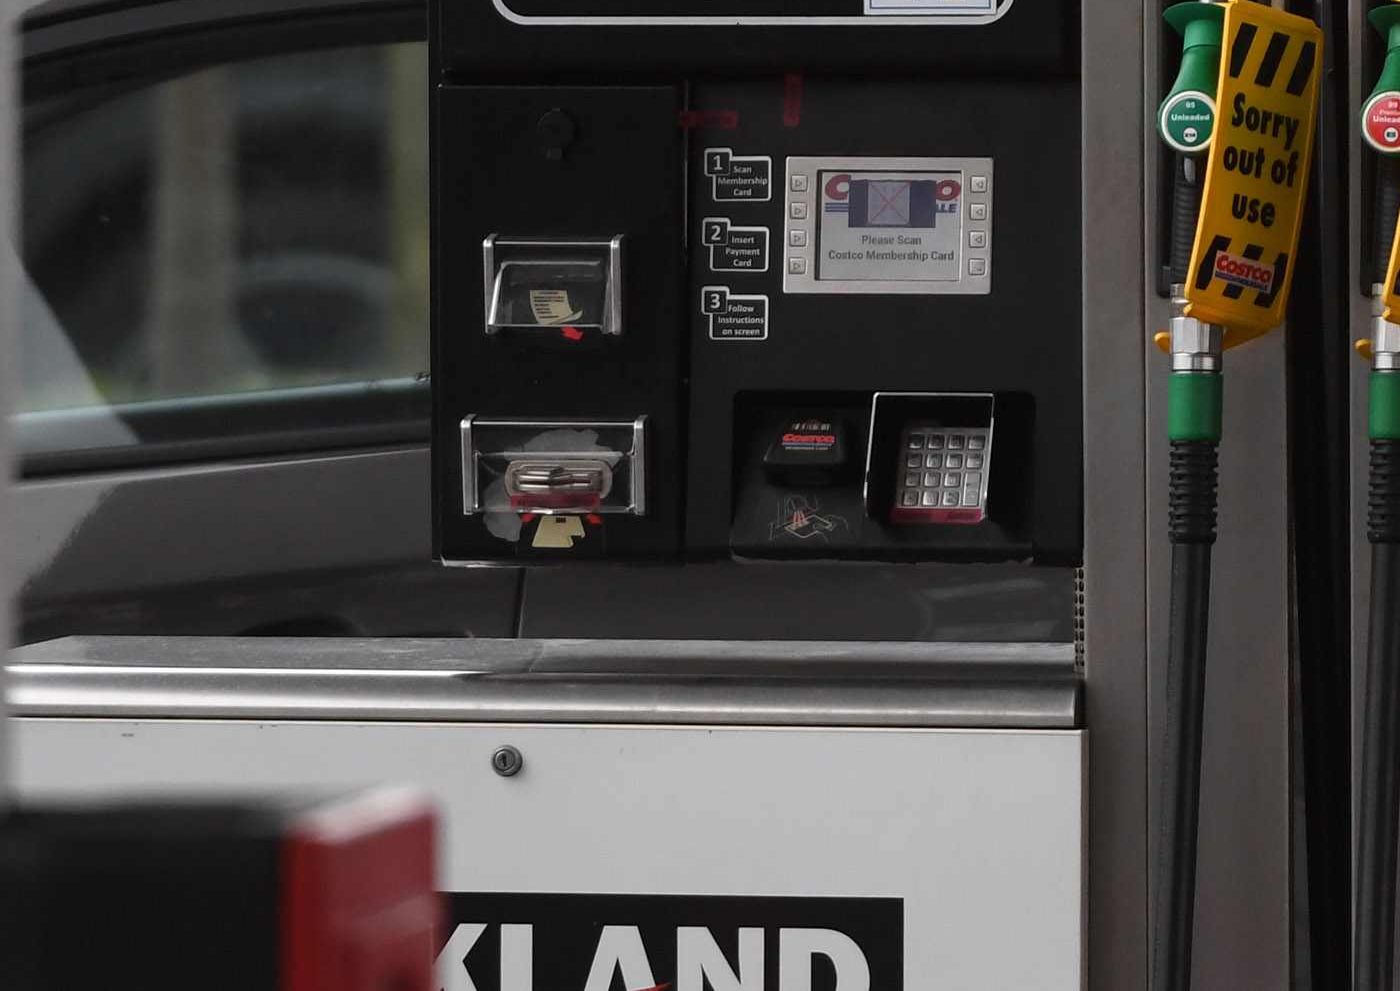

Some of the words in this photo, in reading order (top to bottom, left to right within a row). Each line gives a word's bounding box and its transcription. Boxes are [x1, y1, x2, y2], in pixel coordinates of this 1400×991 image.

[1231, 92, 1299, 151] Sorry
[713, 154, 723, 171] 1
[1223, 145, 1265, 179] out
[1271, 151, 1299, 188] of
[733, 166, 752, 174] Scan
[718, 177, 768, 186] Membership
[733, 188, 752, 196] Card
[1231, 193, 1276, 228] use
[711, 225, 721, 240] 2
[731, 236, 754, 244] Insert
[861, 235, 895, 245] Please
[897, 235, 922, 245] Scan
[725, 247, 760, 256] Payment
[828, 250, 864, 260] Costco
[866, 250, 928, 261] Membership
[931, 251, 955, 260] Card
[733, 259, 752, 267] Card
[1217, 255, 1273, 284] COSTCO
[710, 293, 721, 309] 3
[728, 304, 754, 312] Follow
[718, 316, 764, 324] Instructions
